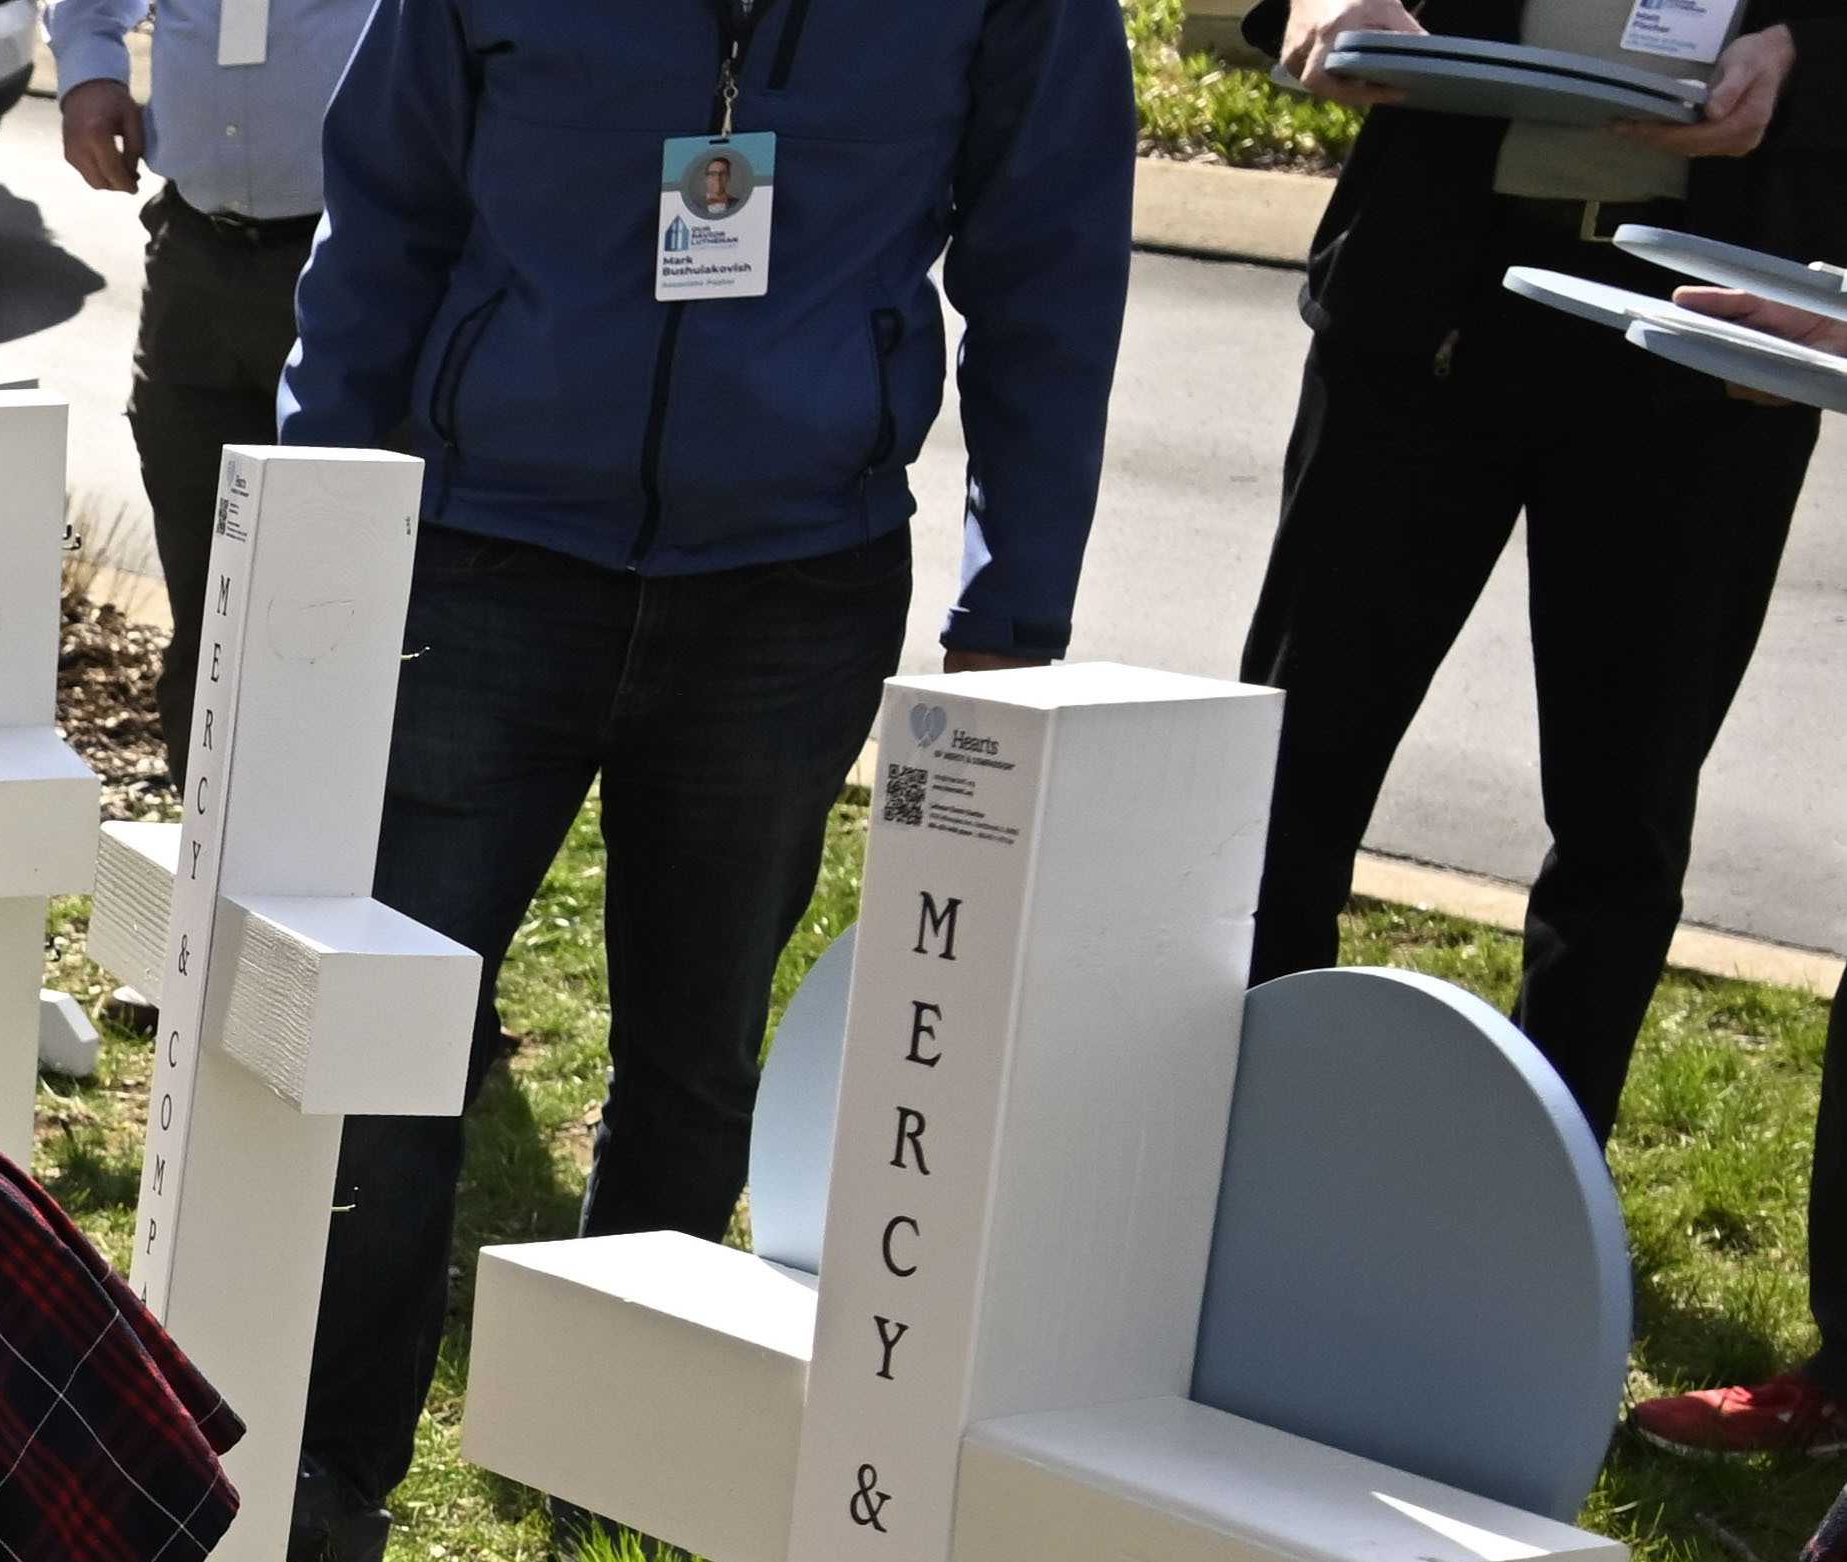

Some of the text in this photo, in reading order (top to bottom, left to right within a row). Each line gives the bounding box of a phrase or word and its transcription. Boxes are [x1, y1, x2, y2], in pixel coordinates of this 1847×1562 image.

[190, 574, 232, 880] MERCY
[951, 729, 1000, 756] Hearts
[178, 934, 194, 978] &
[873, 890, 963, 1381] MERCY
[849, 1463, 892, 1534] &
